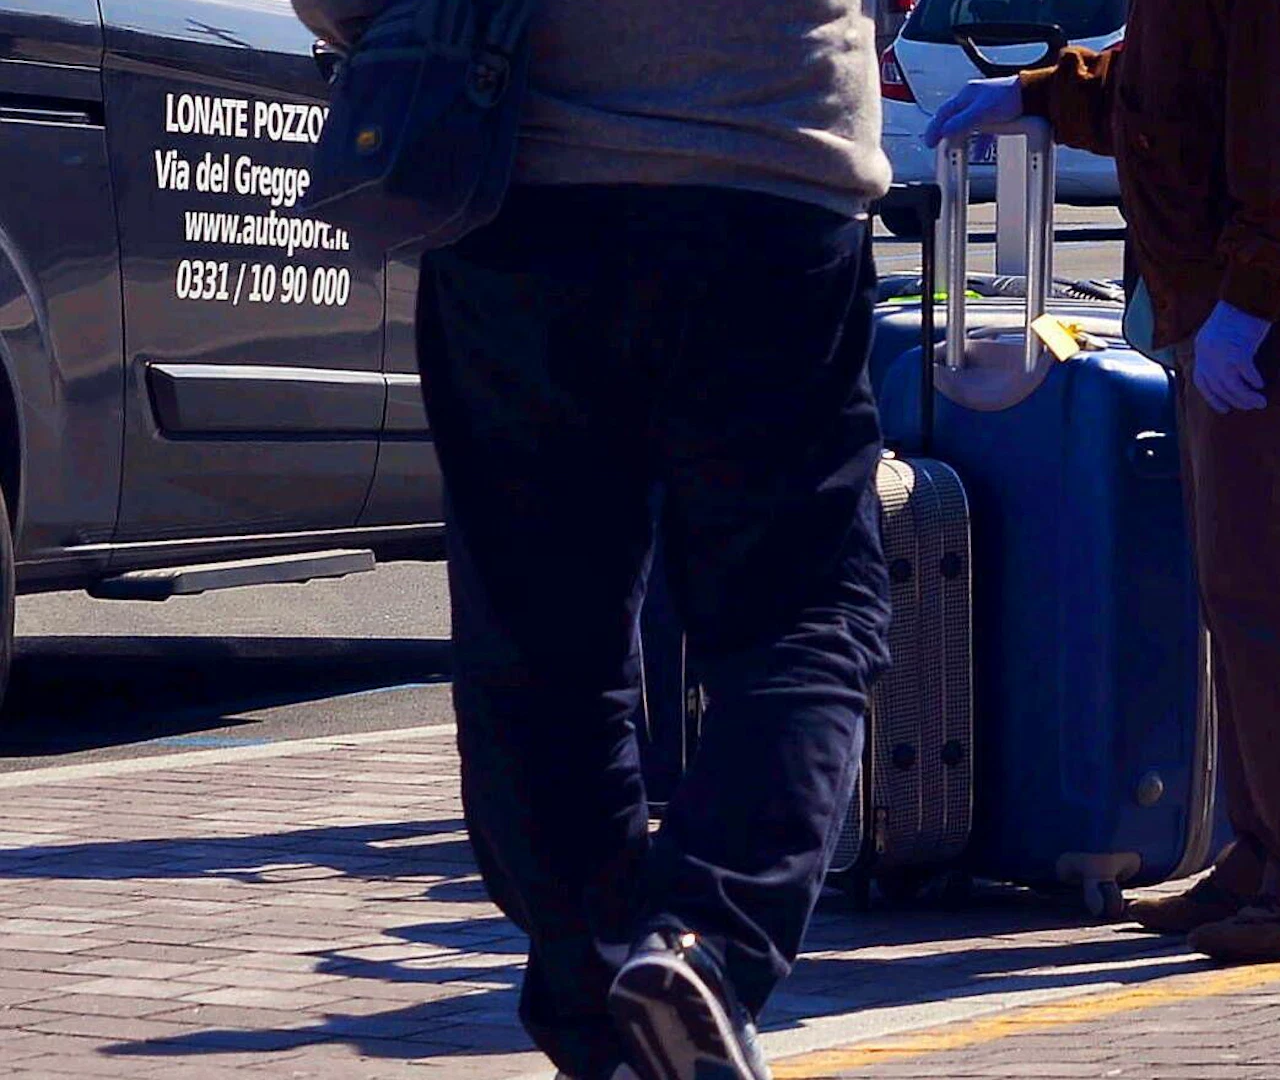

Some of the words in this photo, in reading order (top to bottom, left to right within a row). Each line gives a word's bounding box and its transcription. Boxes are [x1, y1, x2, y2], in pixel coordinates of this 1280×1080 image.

[166, 93, 249, 138] LONATE
[254, 101, 330, 144] POZZO
[155, 149, 190, 190] Via
[196, 152, 230, 193] del
[235, 156, 311, 207] Gregge
[176, 259, 229, 301] 0331
[249, 264, 277, 303] 10
[280, 265, 308, 304] 90
[312, 267, 351, 307] 000
